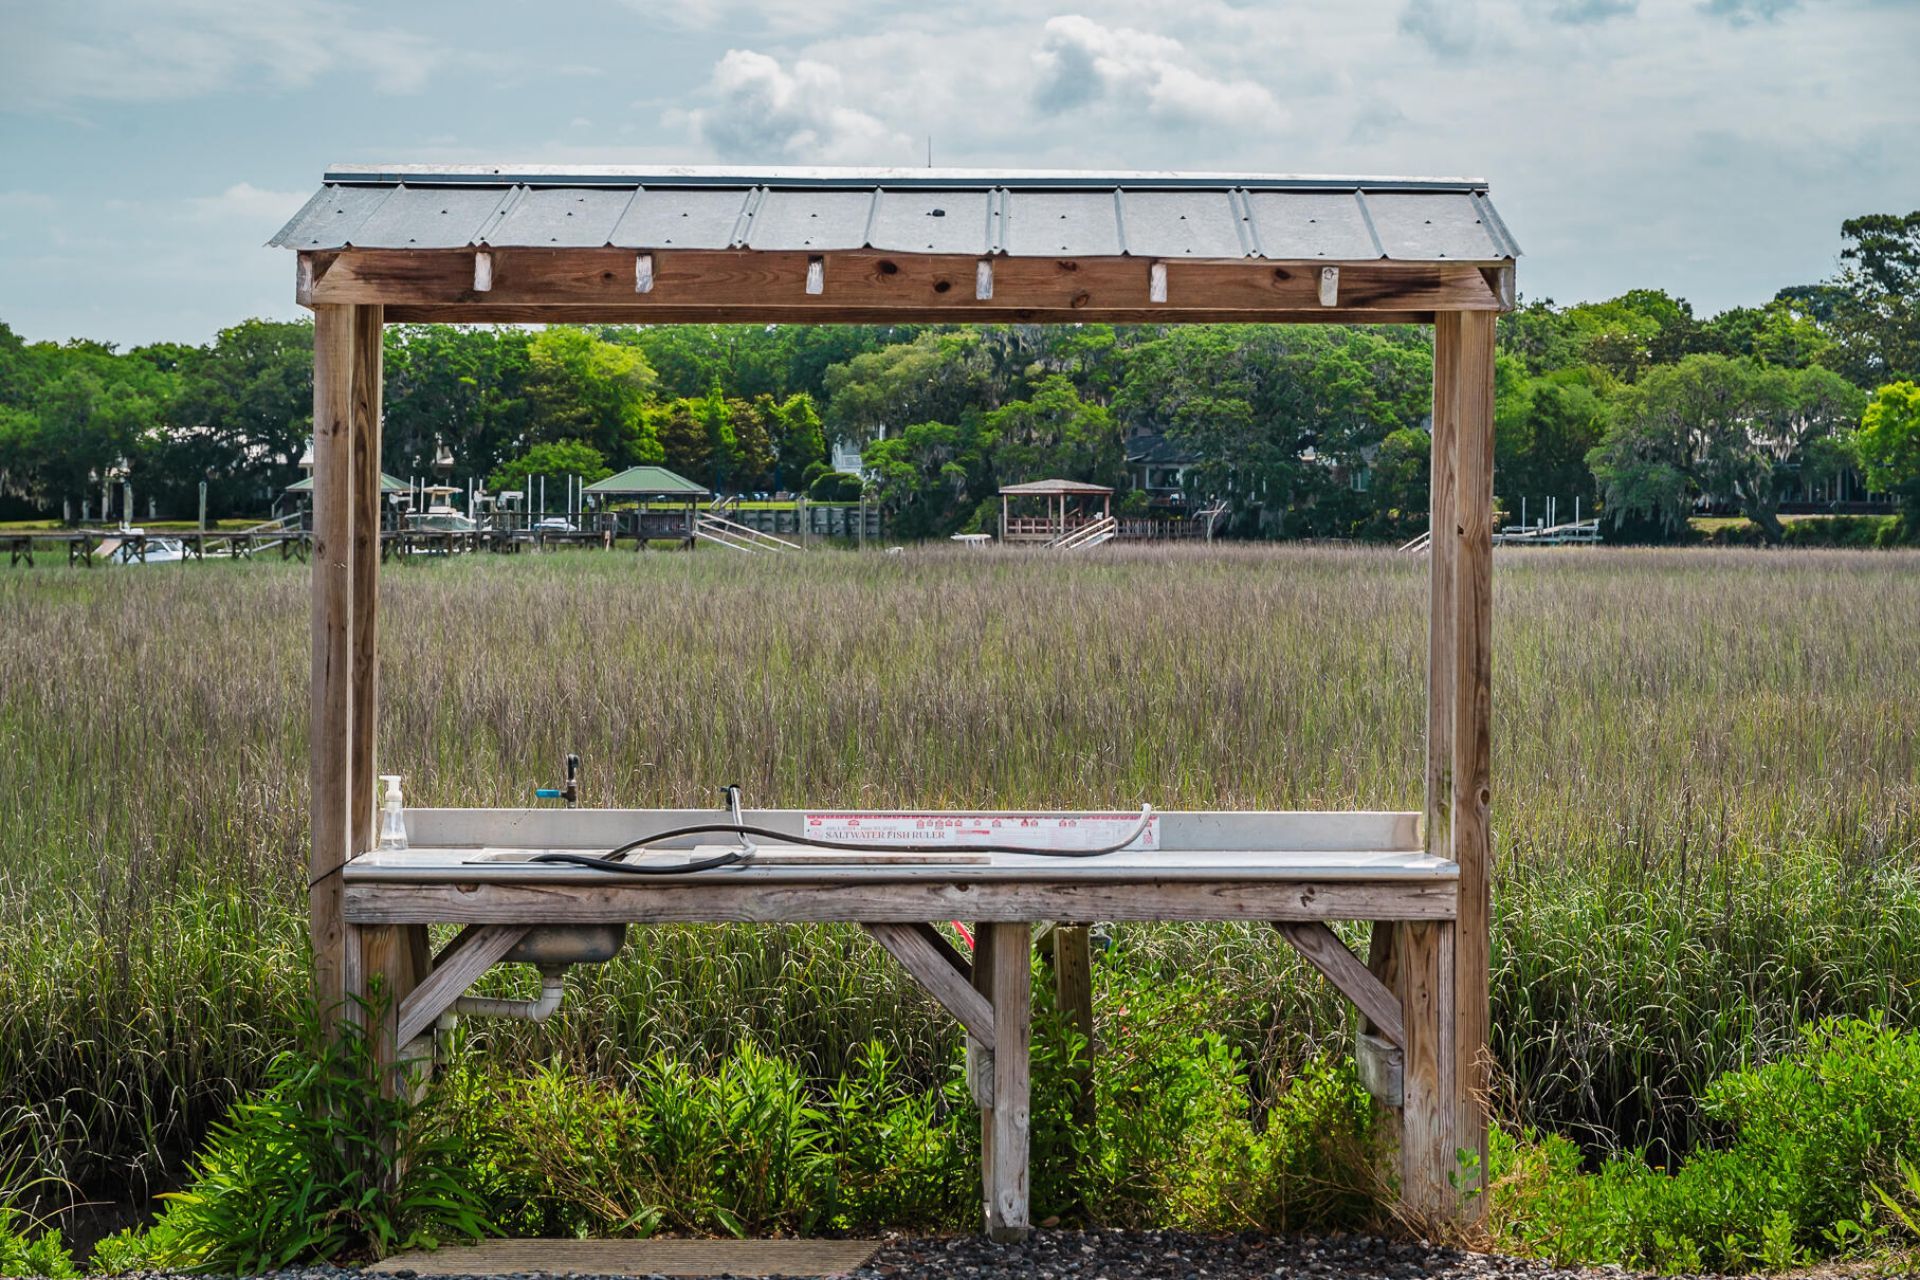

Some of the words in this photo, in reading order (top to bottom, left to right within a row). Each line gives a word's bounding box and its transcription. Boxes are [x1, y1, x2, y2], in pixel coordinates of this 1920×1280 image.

[825, 831, 886, 839] SALTWATER
[887, 831, 910, 839] FISH
[912, 831, 945, 839] RULER
